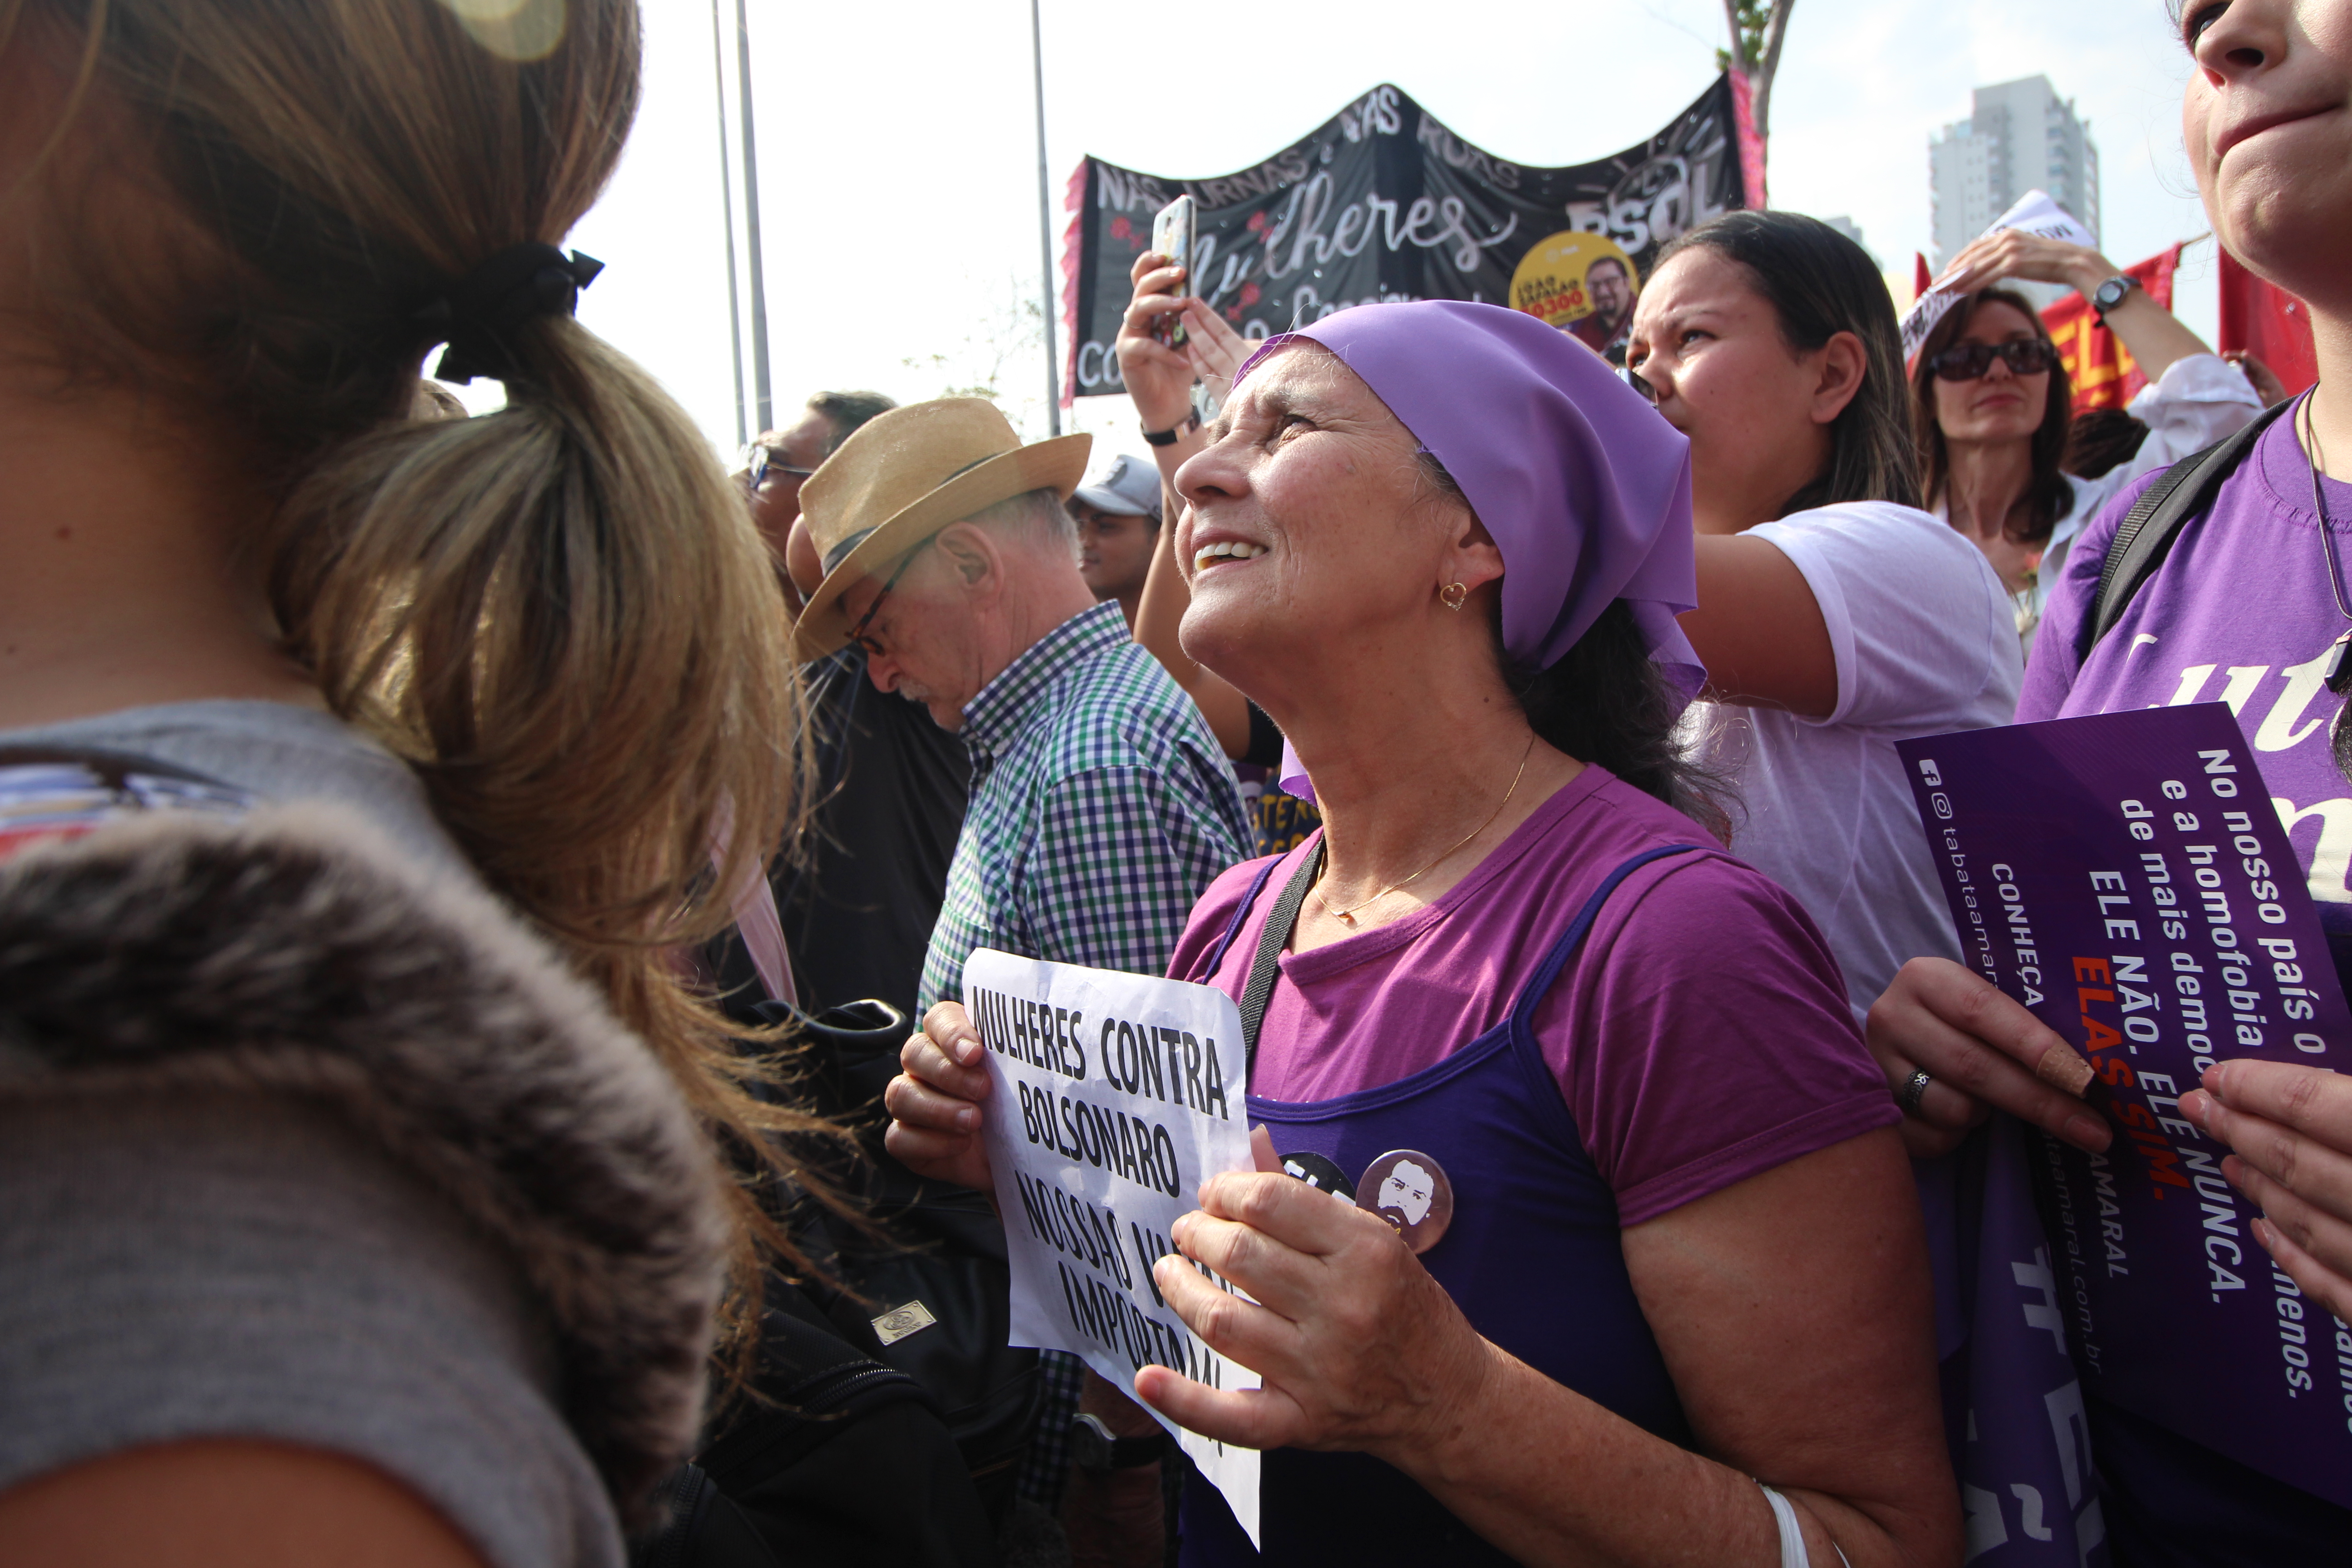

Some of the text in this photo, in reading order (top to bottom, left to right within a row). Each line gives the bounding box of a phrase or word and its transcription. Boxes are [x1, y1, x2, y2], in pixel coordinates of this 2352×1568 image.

[1096, 162, 1171, 213] NAS
[1181, 148, 1310, 210] URNAS
[1416, 111, 1521, 189] RUAS
[1943, 827, 1998, 988] tabataamar
[1992, 863, 2044, 1007] CONHEÇA
[2120, 799, 2155, 841] de
[2139, 853, 2189, 940] mais
[2161, 779, 2268, 1047] e a homofobia
[2197, 749, 2239, 799] No
[2222, 811, 2287, 925] nosso
[2256, 937, 2321, 1020] país
[2293, 1032, 2326, 1054] o
[972, 985, 1229, 1121] MULHERES CONTRA
[2073, 956, 2190, 1201] ELAS SIM.
[2088, 871, 2246, 1304] ELE NÃO. ELE NUNCA.
[1019, 1079, 1180, 1199] BOLSONARO
[1014, 1169, 1132, 1290] NOSSAS
[2089, 1152, 2129, 1279] AMARAL
